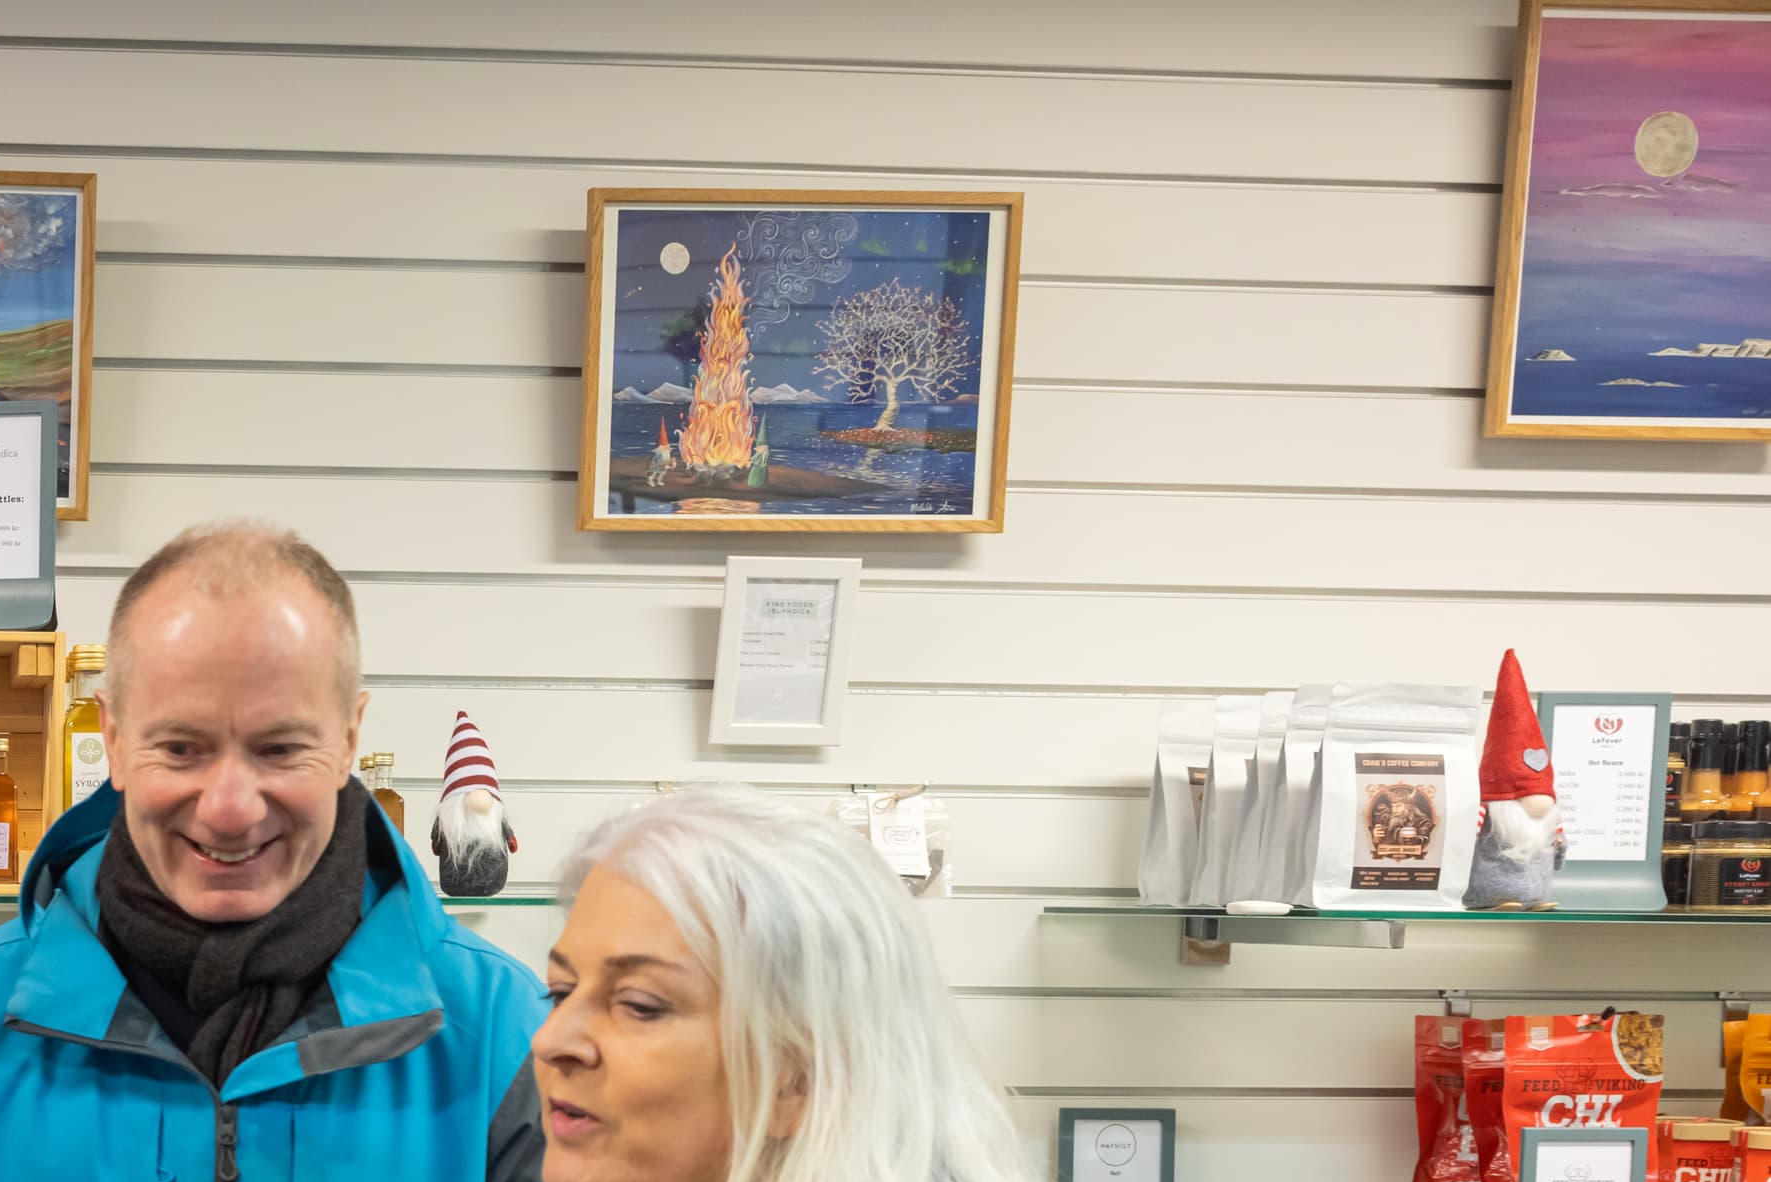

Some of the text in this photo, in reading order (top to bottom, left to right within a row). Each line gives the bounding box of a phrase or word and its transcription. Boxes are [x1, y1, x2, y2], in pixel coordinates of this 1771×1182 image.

[1522, 1078, 1645, 1093] FEED VIKING
[1676, 1158, 1709, 1167] FEED
